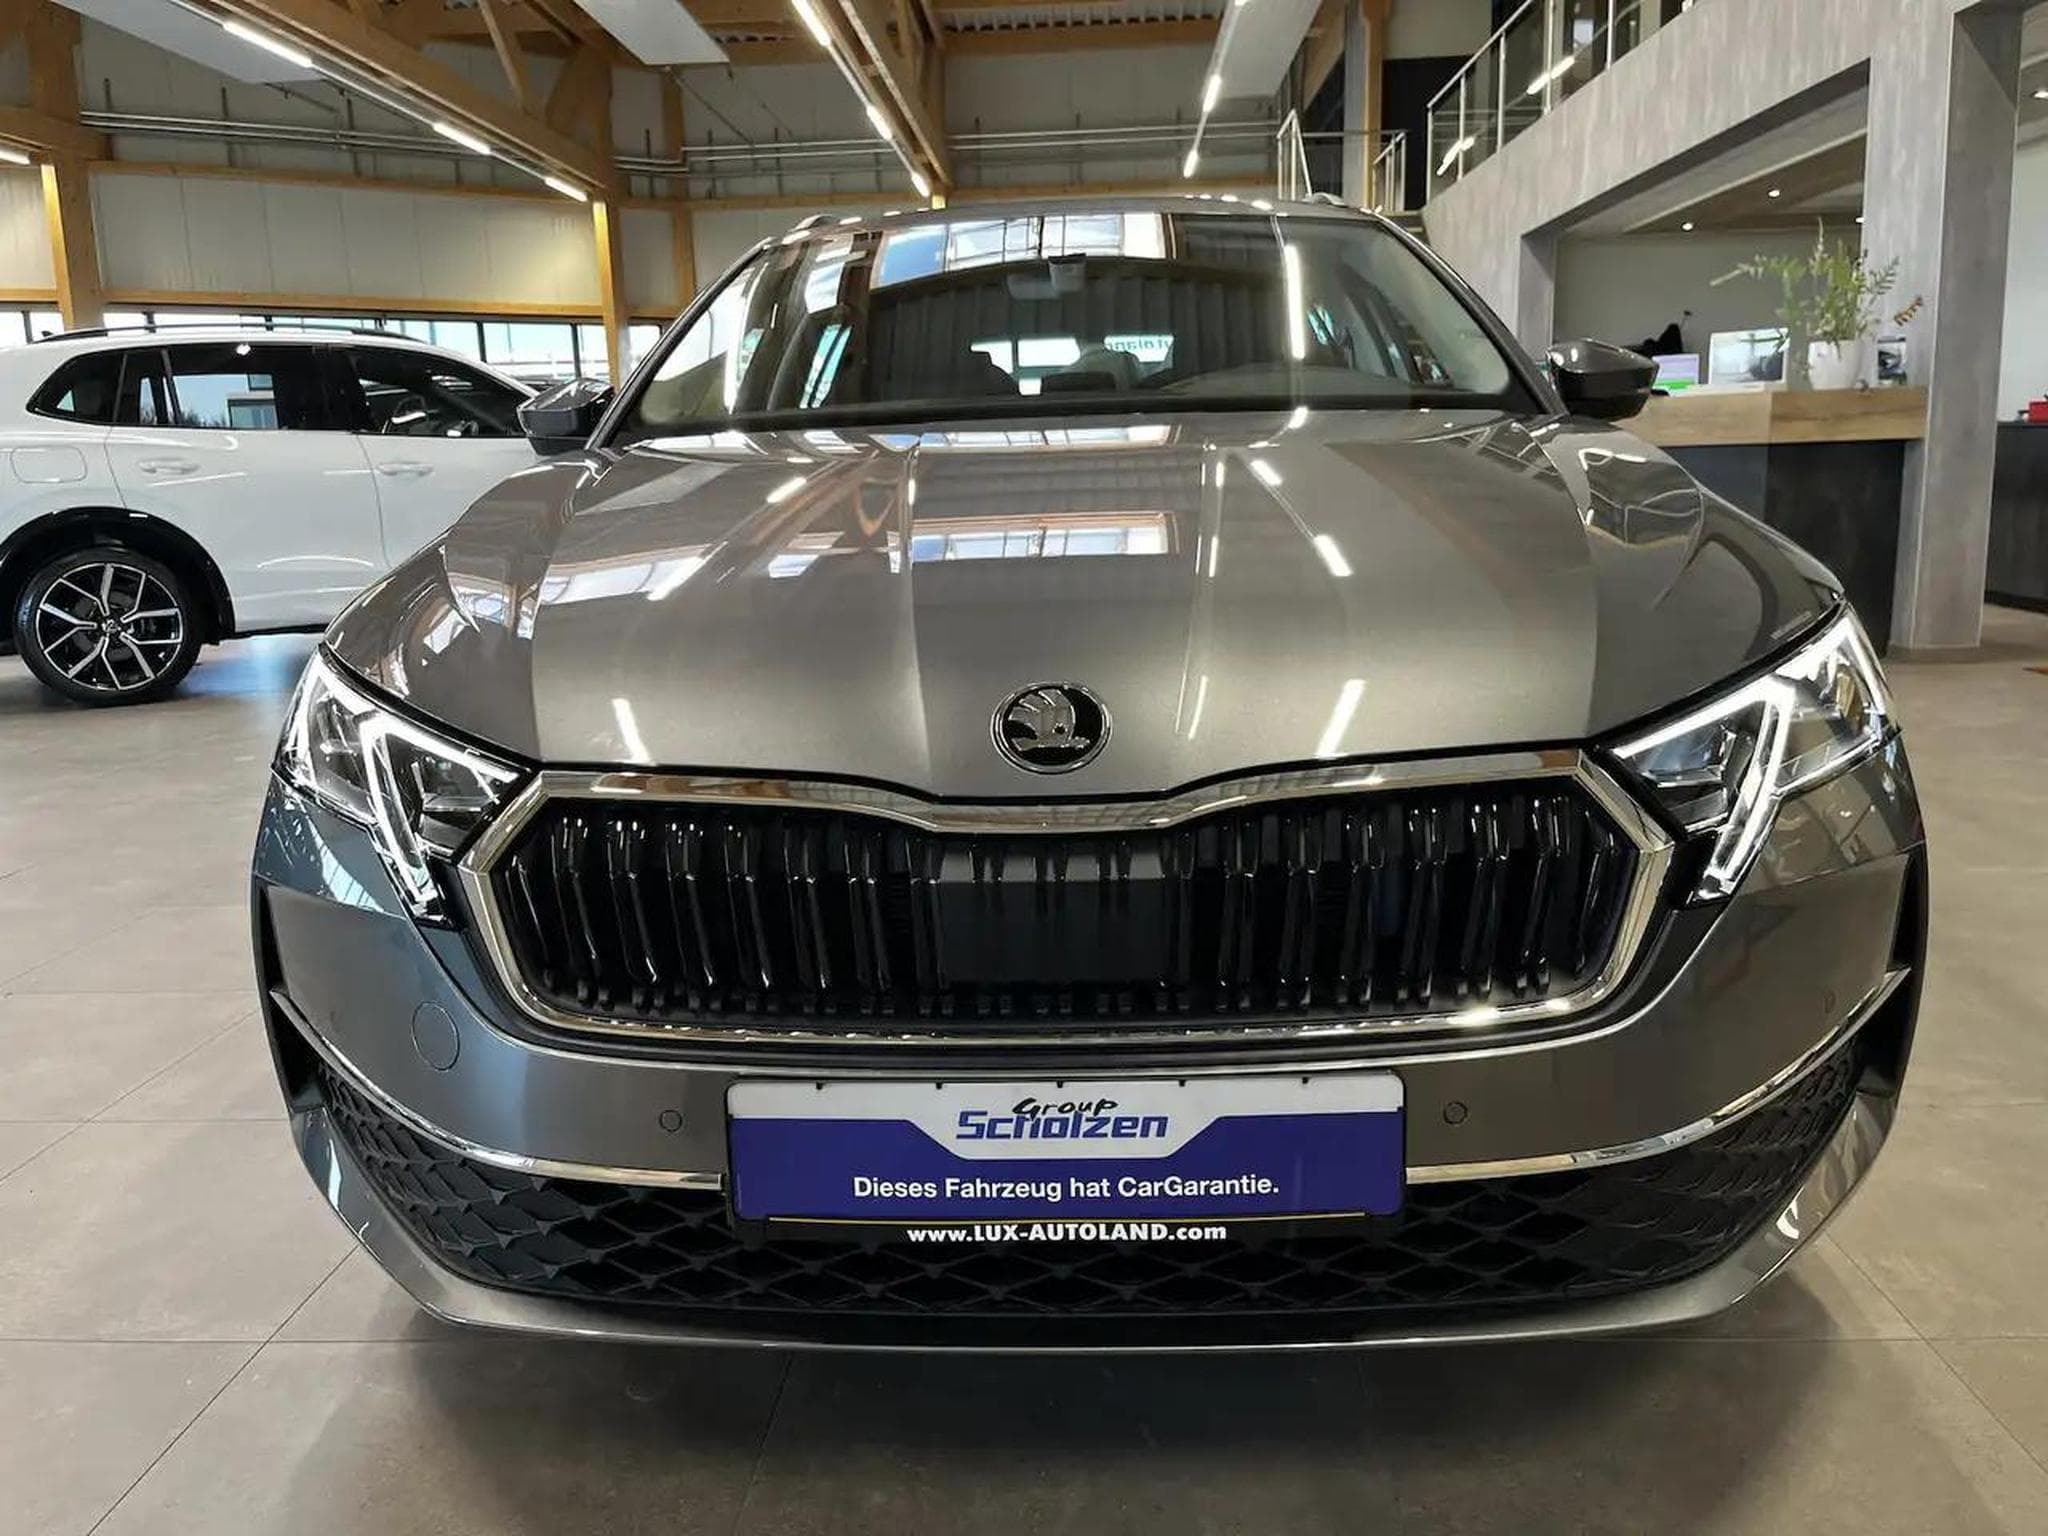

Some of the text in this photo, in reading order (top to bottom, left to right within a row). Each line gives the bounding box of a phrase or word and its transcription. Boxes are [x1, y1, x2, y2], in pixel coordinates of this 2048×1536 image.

[1012, 1097, 1119, 1121] Group
[956, 1111, 1169, 1139] Scholzen
[853, 1174, 1280, 1202] Dieses Fahrzeug hat CarGarantie.
[906, 1223, 1227, 1243] www.LUX-AUTOLAND.com
